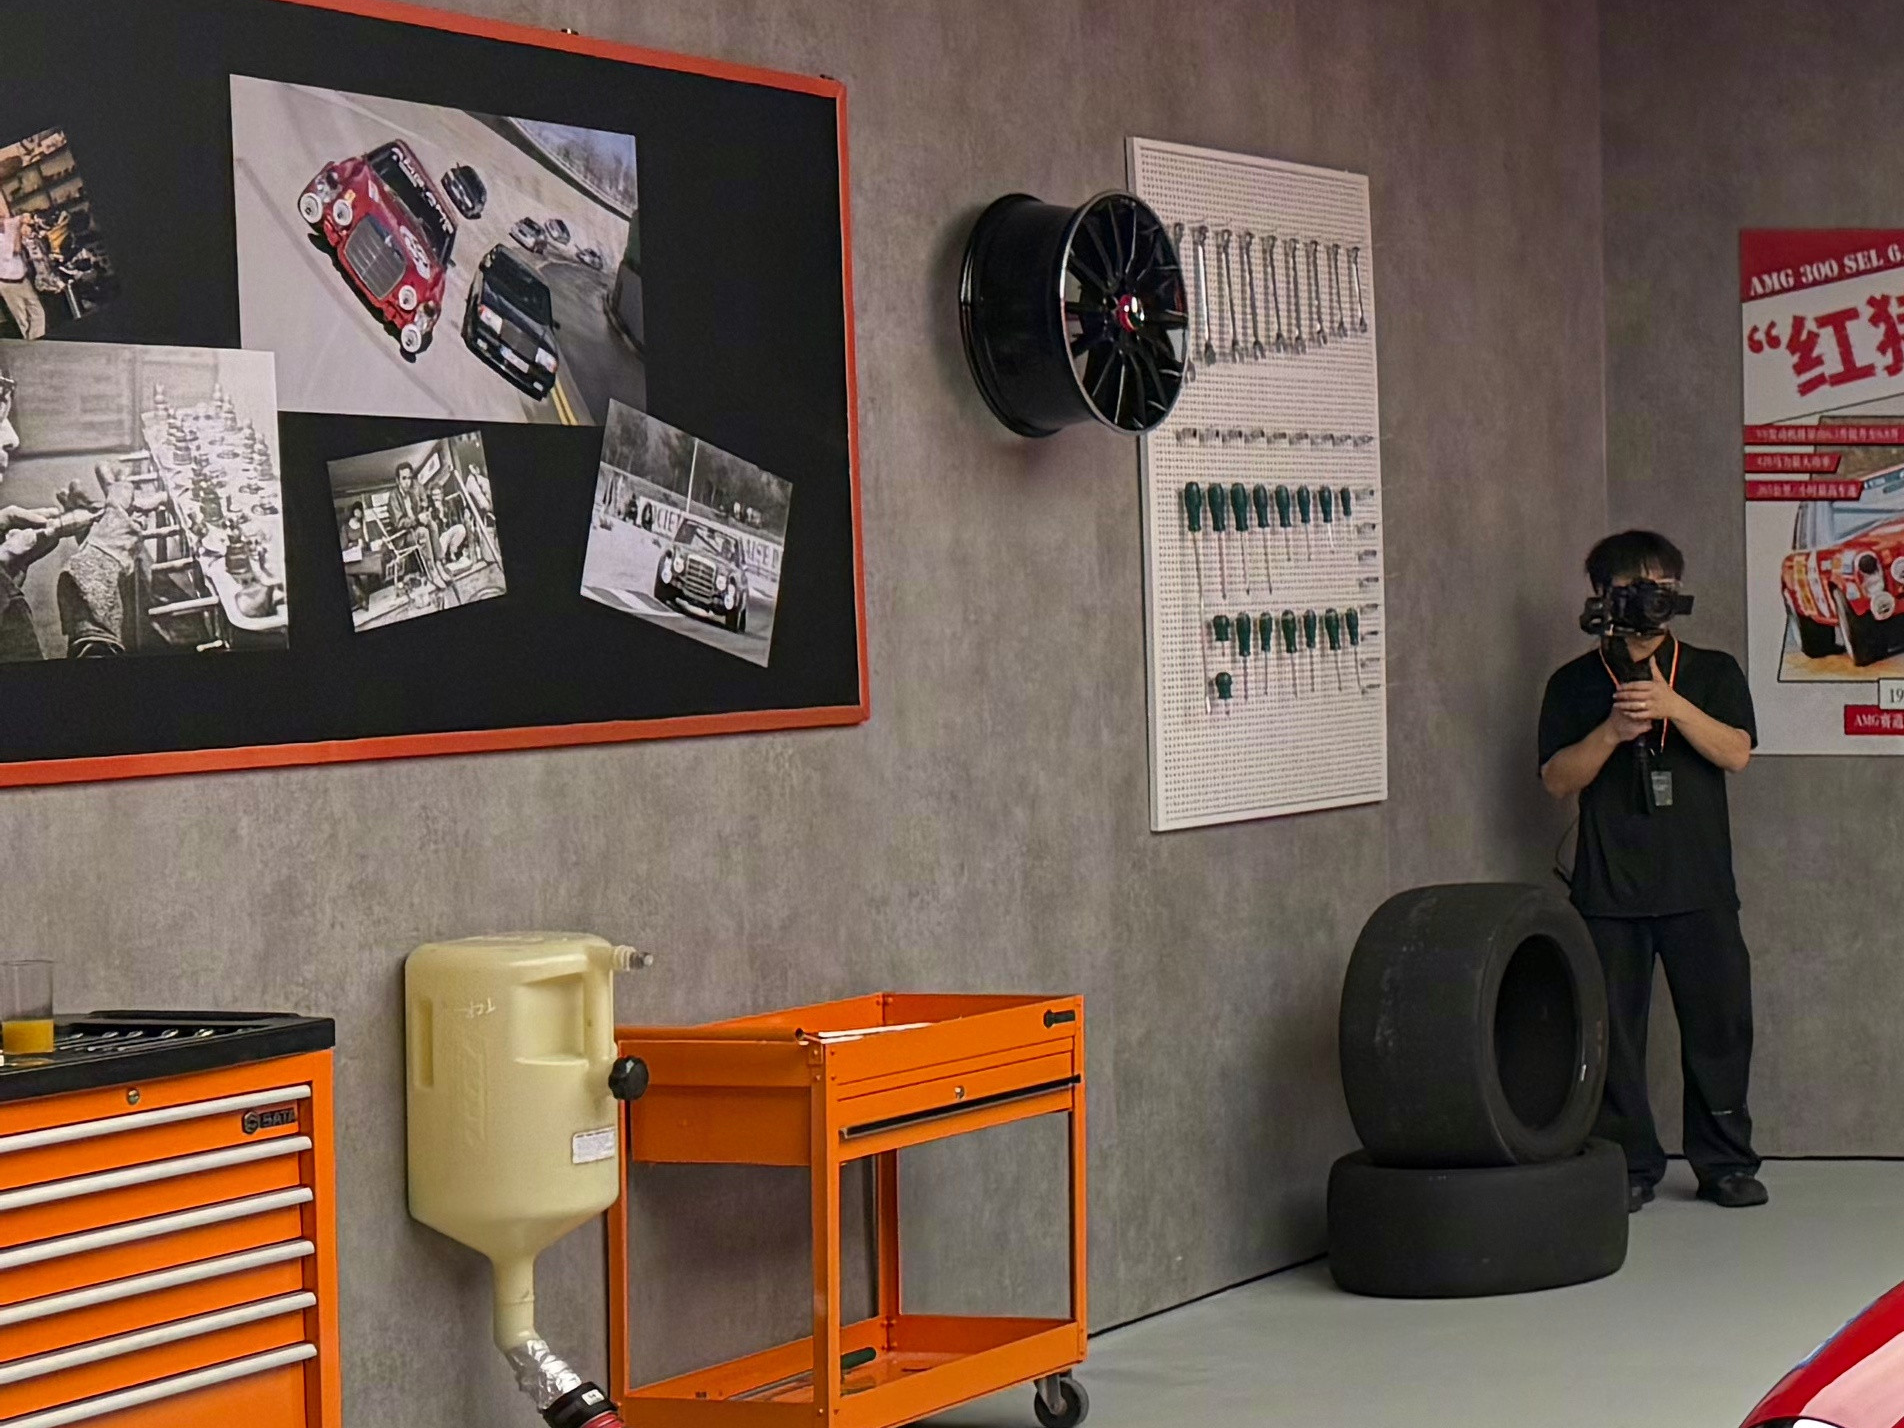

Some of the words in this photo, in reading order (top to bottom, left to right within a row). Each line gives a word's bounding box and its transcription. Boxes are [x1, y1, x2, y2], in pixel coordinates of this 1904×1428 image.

[1749, 269, 1795, 297] AMG
[1800, 258, 1839, 285] 300
[1844, 249, 1884, 273] SEL
[260, 1108, 297, 1128] SATA
